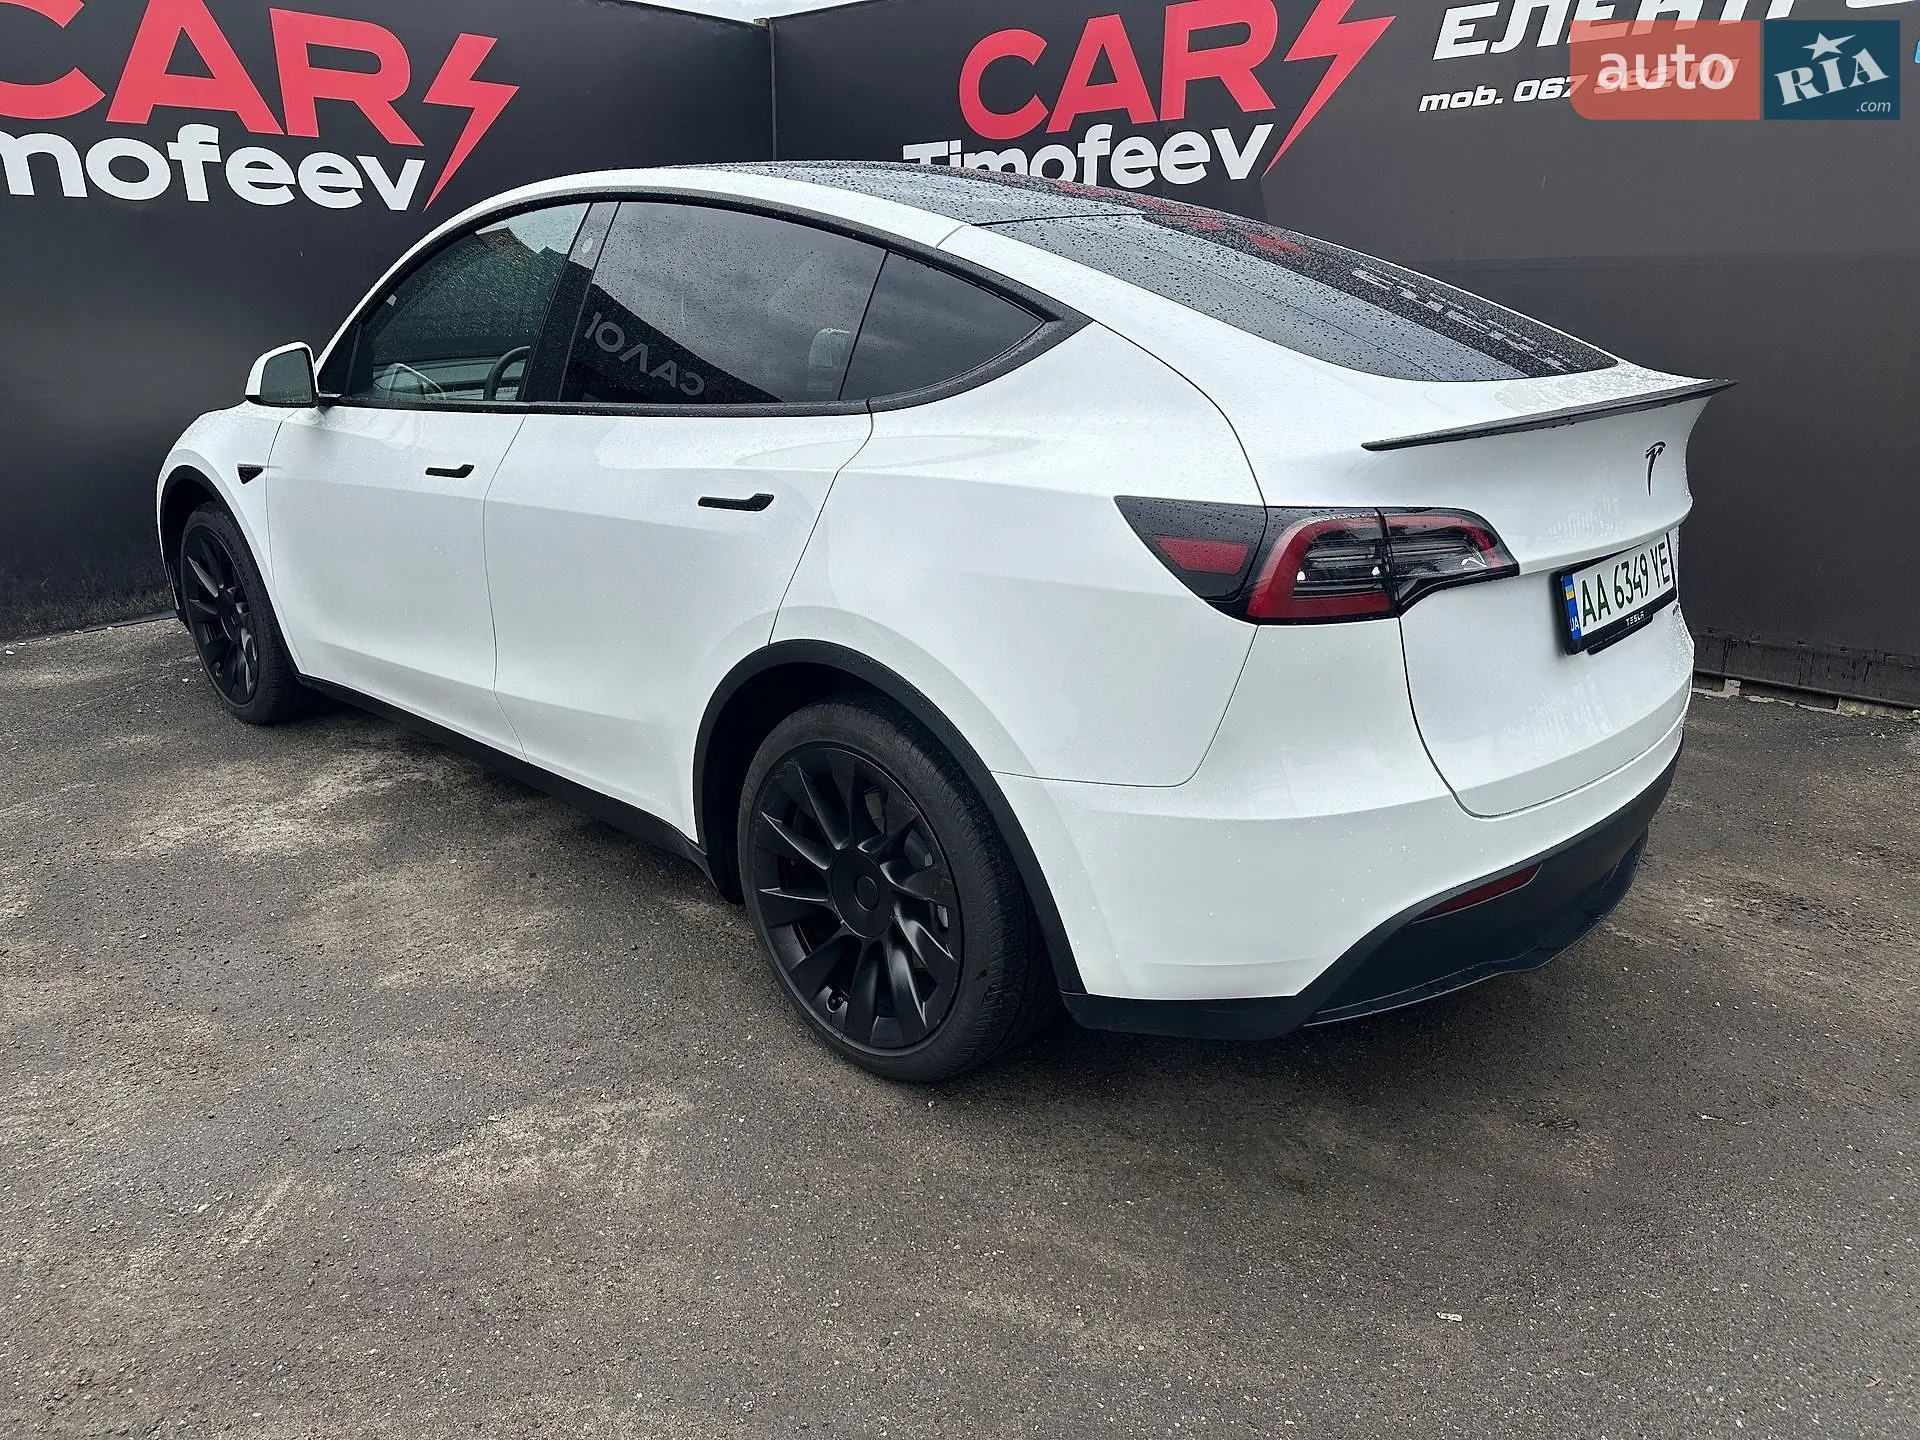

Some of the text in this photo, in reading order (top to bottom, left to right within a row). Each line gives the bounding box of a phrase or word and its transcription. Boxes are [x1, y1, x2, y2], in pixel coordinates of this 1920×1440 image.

[1419, 84, 1503, 112] mob.
[1513, 74, 1588, 102] 067
[1581, 541, 1671, 627] AA 6349 YE
